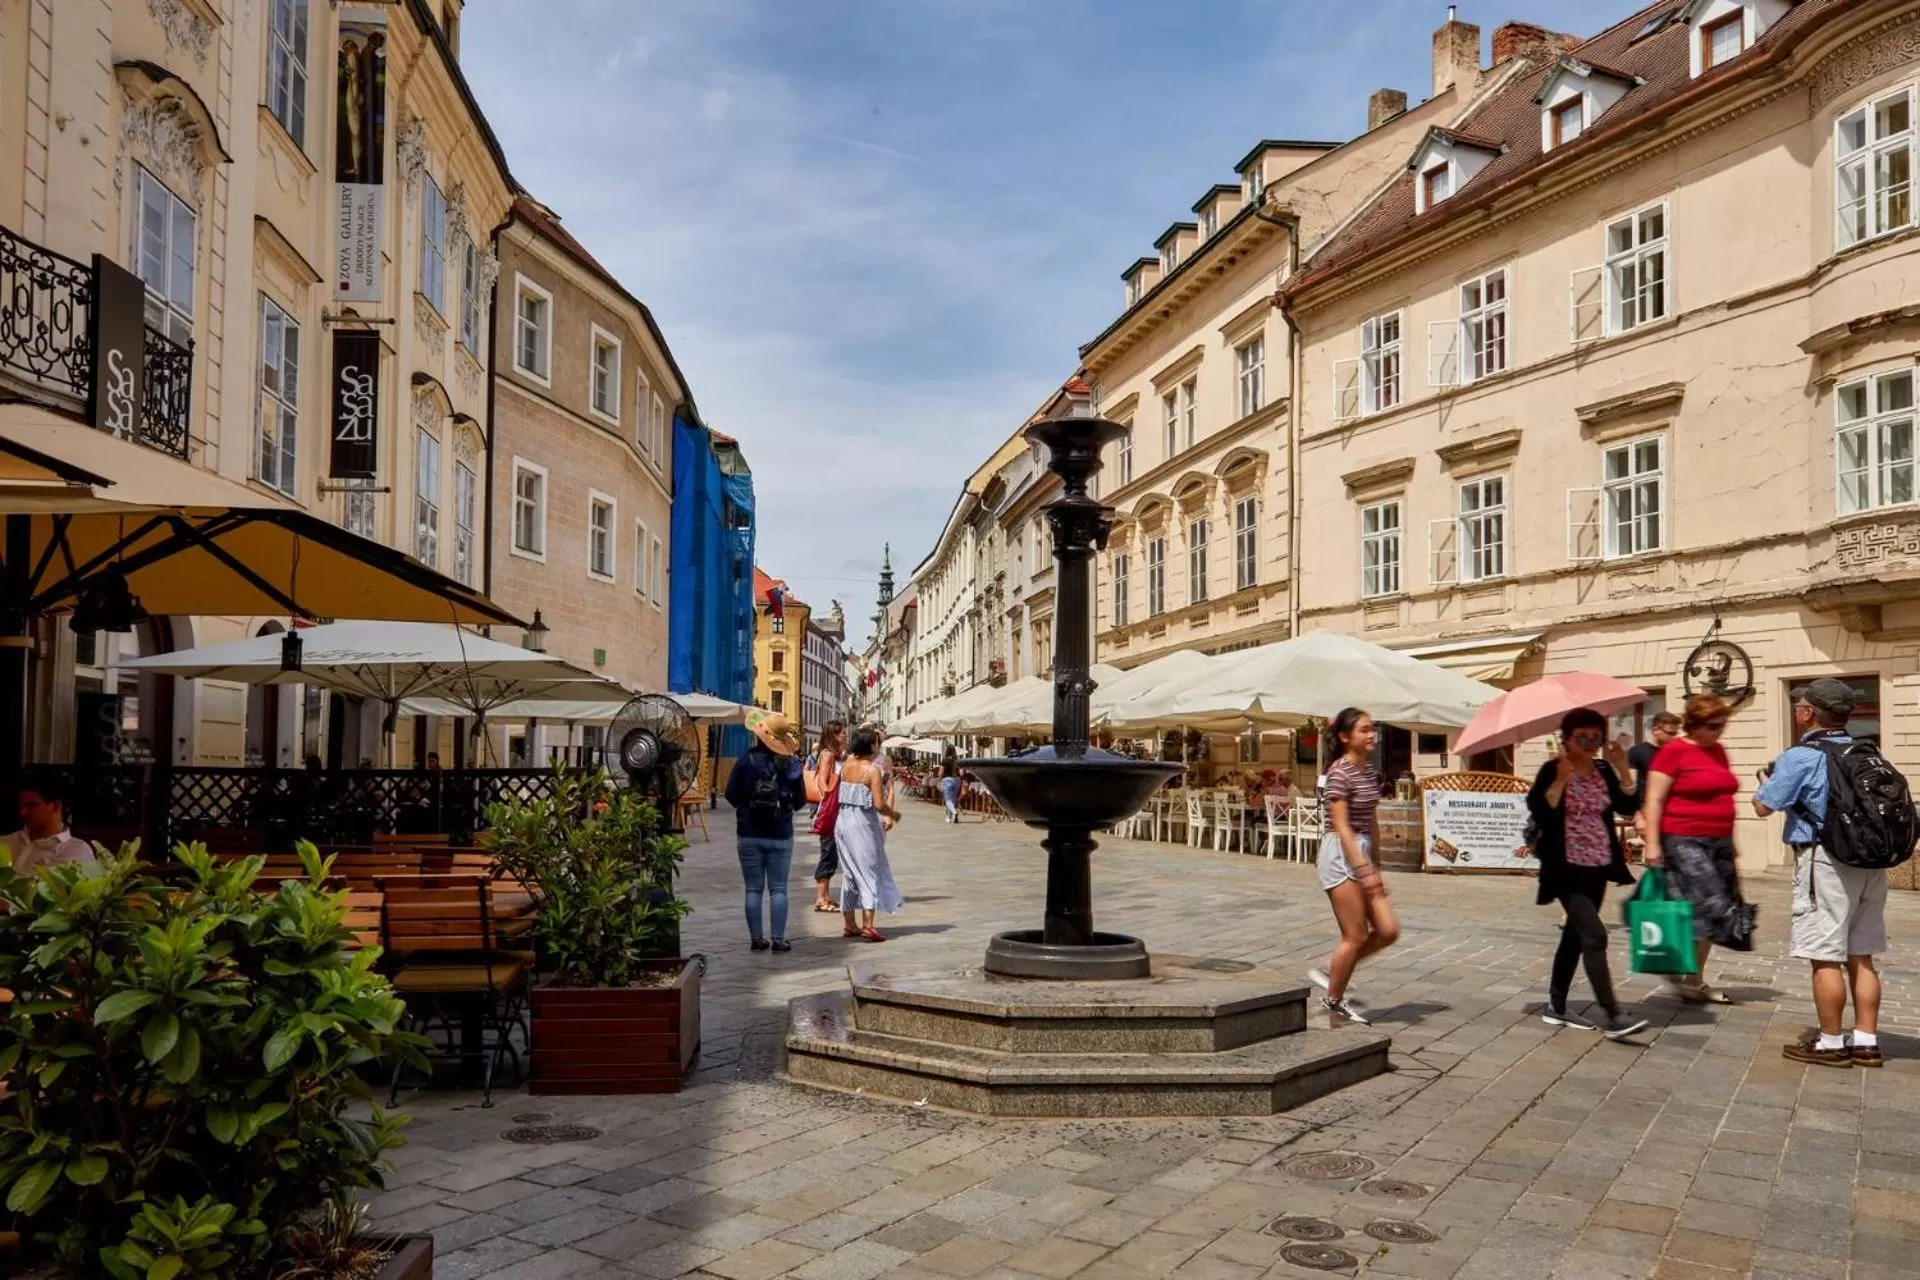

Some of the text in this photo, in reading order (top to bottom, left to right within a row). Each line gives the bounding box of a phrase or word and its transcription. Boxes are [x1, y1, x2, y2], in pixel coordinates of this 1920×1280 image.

[340, 186, 352, 280] ZOYA GALLERY
[357, 204, 365, 237] PALACE
[107, 349, 135, 401] Sa
[340, 365, 374, 396] Sa
[1448, 800, 1487, 808] RESTAURANT
[1641, 921, 1663, 945] D
